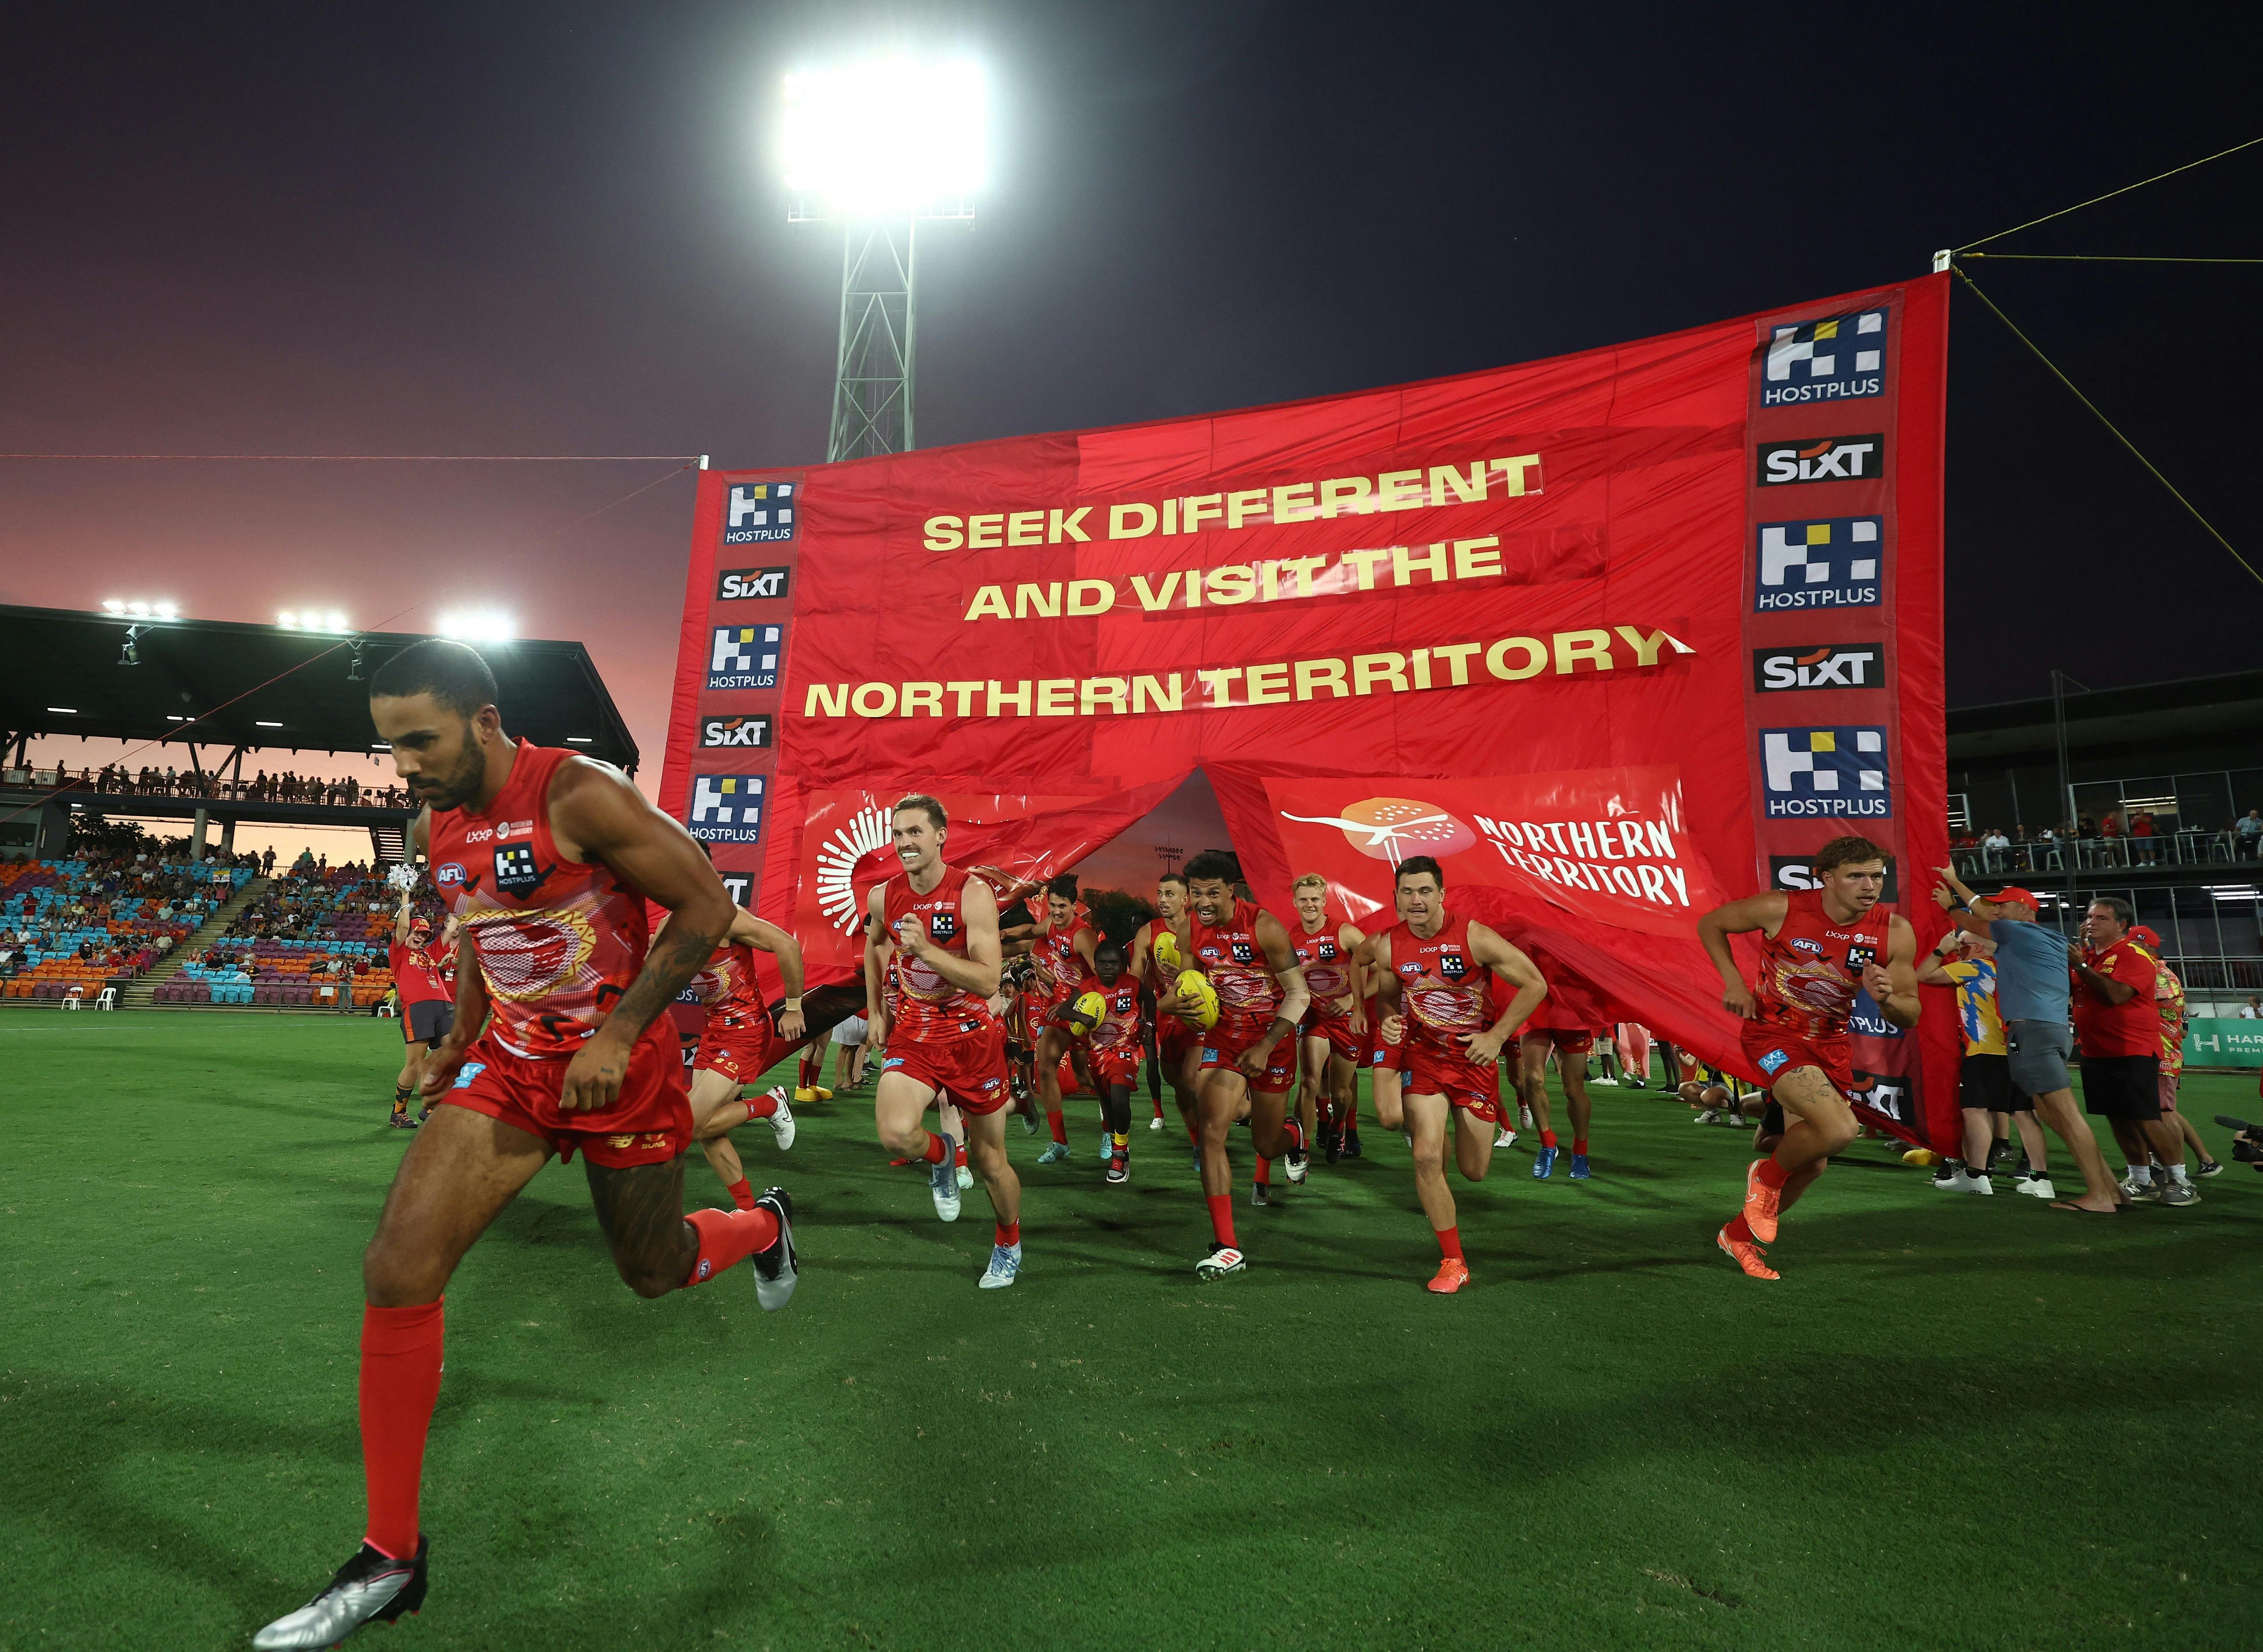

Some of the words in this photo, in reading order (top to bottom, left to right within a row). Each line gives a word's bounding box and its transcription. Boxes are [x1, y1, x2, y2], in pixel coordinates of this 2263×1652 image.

[1766, 378, 1880, 404] HOSTPLUS
[923, 506, 1094, 551] SEEK
[1108, 453, 1540, 540] DIFFERENT
[726, 528, 791, 542] HOSTPLUS
[964, 579, 1116, 621] AND
[1130, 556, 1327, 612] VISIT
[1342, 536, 1502, 591] THE
[1759, 587, 1876, 608] HOSTPLUS
[804, 672, 1183, 718] NORTHERN
[1199, 625, 1670, 707] TERRITORY
[709, 675, 774, 688] HOSTPLUS
[1770, 799, 1886, 815] HOSTPLUS
[690, 827, 757, 841] HOSTPLUS
[1473, 814, 1676, 860] NORTHERN
[438, 868, 464, 882] AFL
[499, 875, 536, 885] HOSTPLUS
[1487, 838, 1690, 907] TERRITORY
[1794, 940, 1820, 953] AFL
[984, 1079, 999, 1089] AFL
